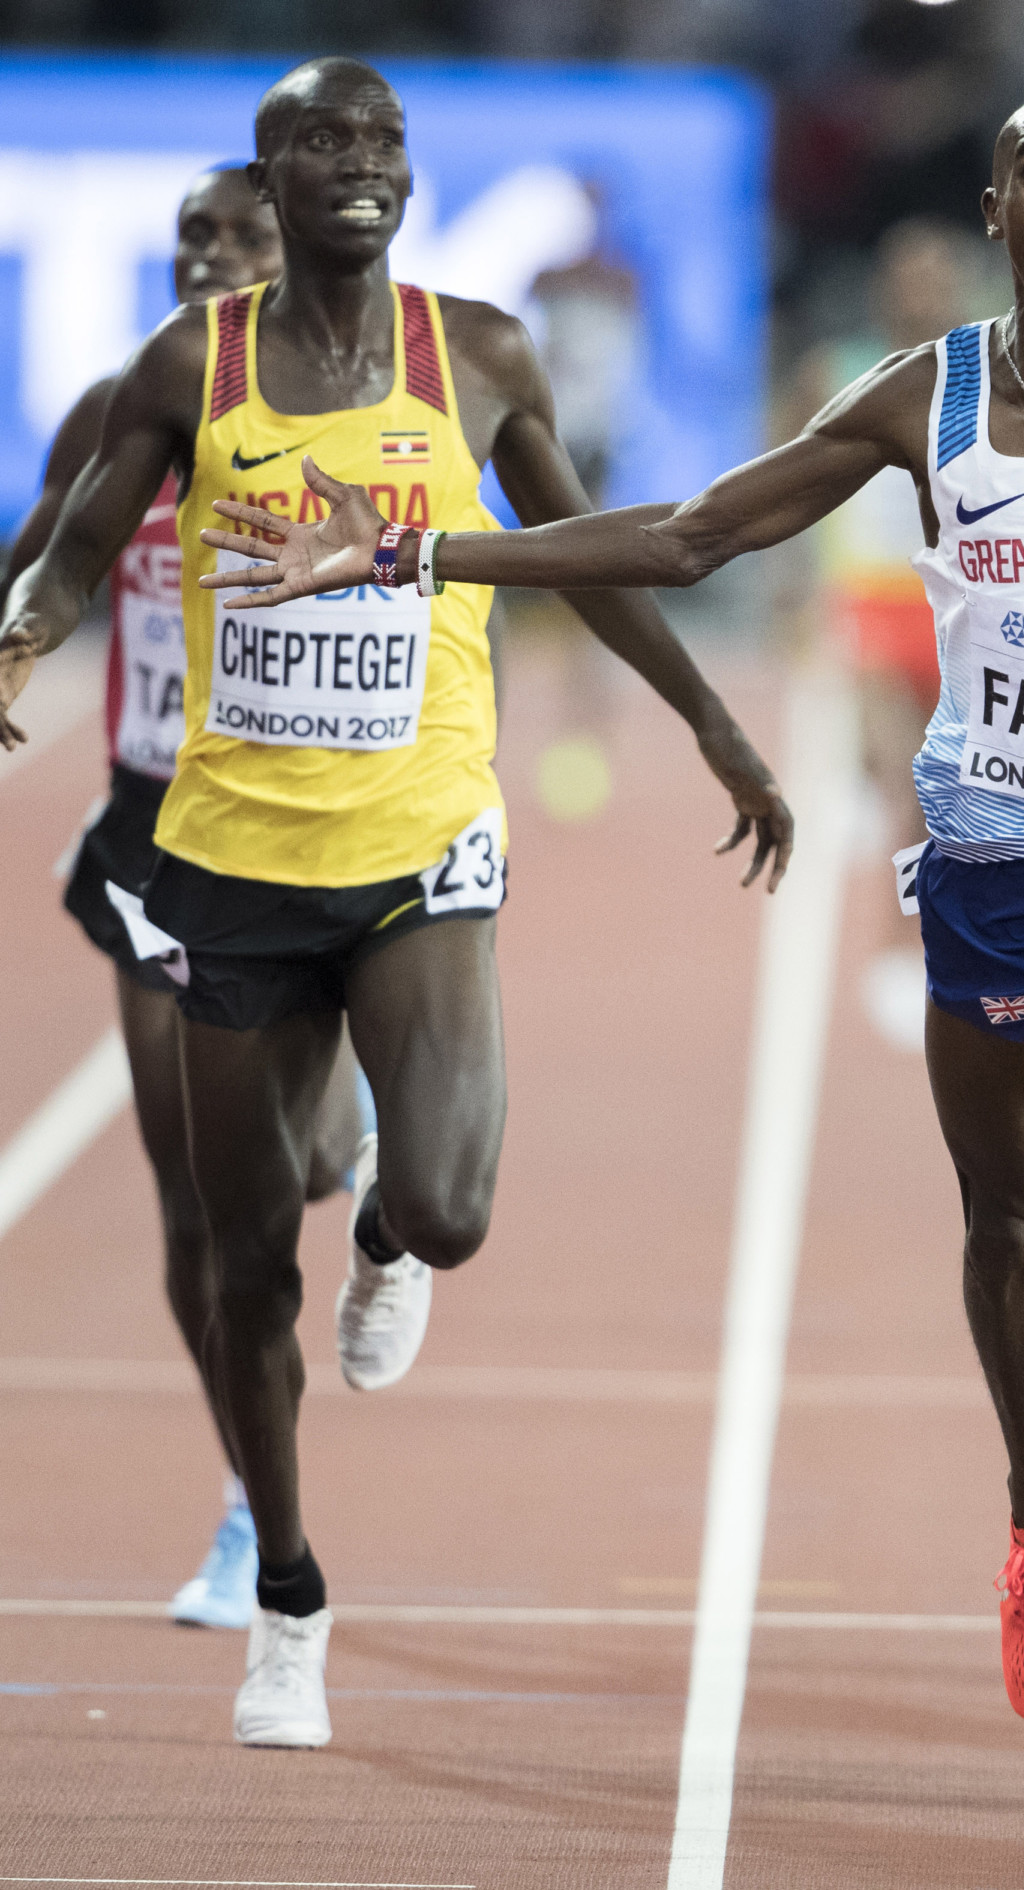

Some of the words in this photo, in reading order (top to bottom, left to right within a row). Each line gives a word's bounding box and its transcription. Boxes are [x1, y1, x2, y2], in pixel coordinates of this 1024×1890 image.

[221, 617, 416, 692] CHEPTEGEI
[215, 700, 340, 738] LONDON
[347, 713, 413, 741] 2017
[431, 830, 496, 898] 23
